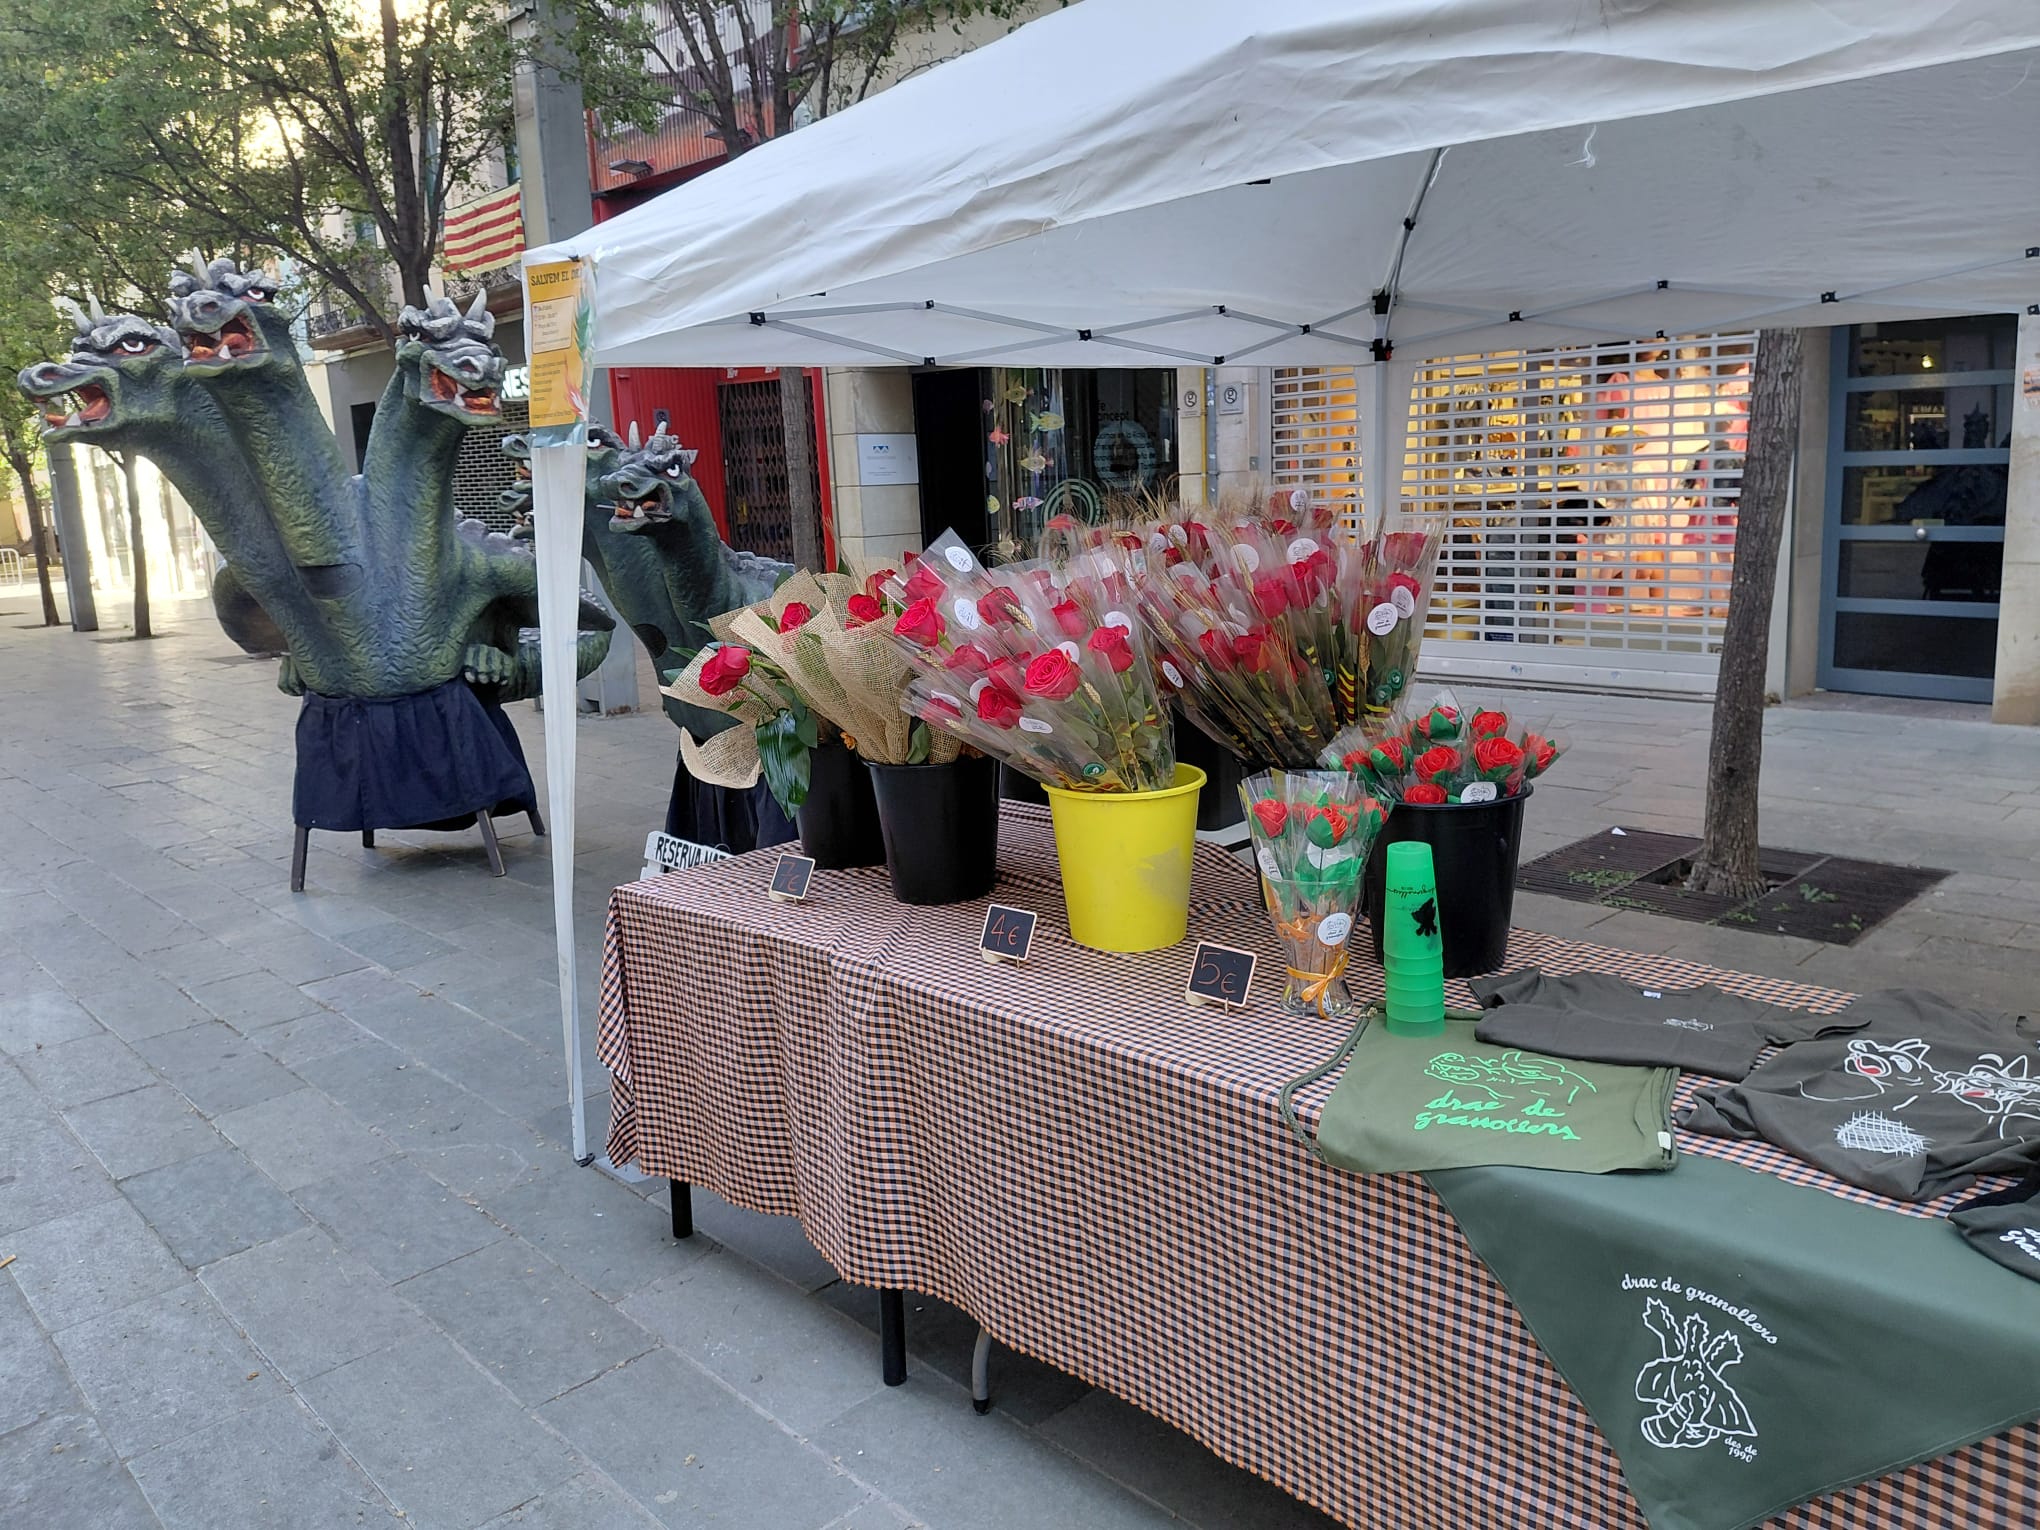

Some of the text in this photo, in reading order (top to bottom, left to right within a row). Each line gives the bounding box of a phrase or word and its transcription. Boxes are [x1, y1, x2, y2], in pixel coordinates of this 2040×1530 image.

[531, 272, 560, 286] SALVEM
[561, 270, 569, 281] EL
[991, 913, 1021, 946] 4€
[1198, 951, 1238, 994] 5€
[1521, 1098, 1565, 1117] de
[1621, 1273, 1778, 1344] drac de granollers
[1724, 1436, 1758, 1457] des de
[1728, 1447, 1753, 1463] 1990
